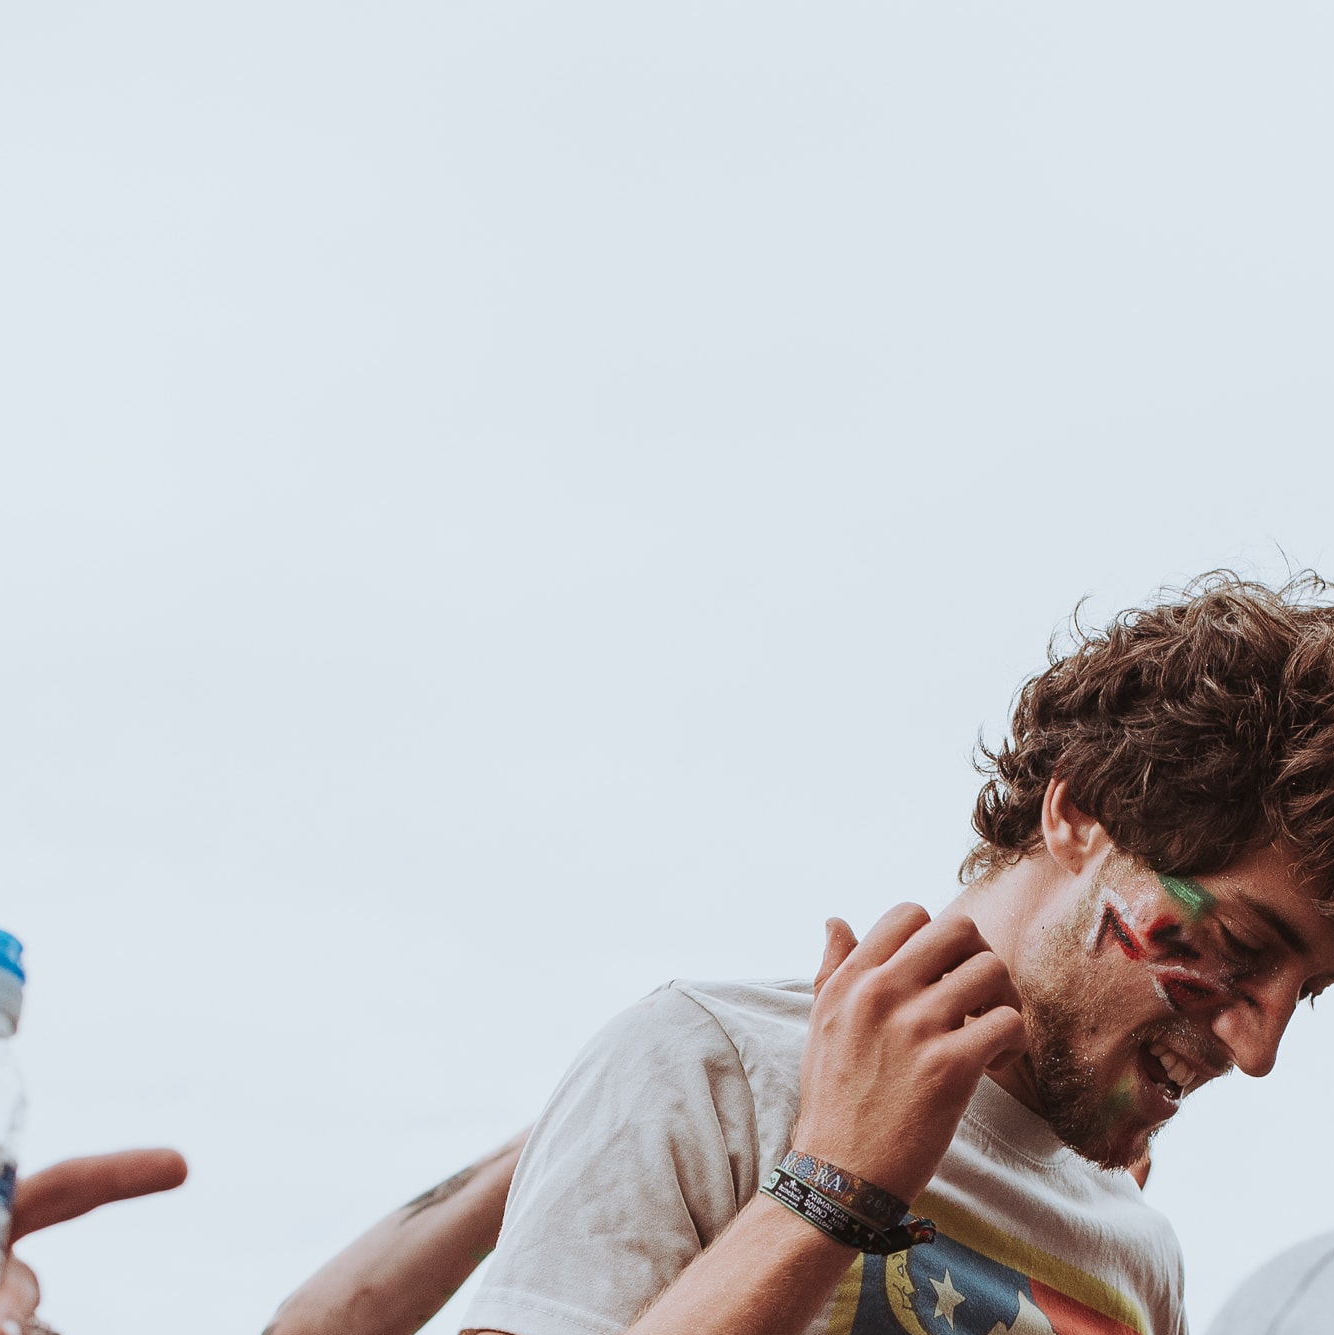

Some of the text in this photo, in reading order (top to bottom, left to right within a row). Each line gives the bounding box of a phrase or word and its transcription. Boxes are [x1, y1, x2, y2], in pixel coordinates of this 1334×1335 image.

[804, 1199, 828, 1219] SOUND
[807, 1191, 849, 1223] PRIMAVERA
[805, 1209, 833, 1231] BARCELONA
